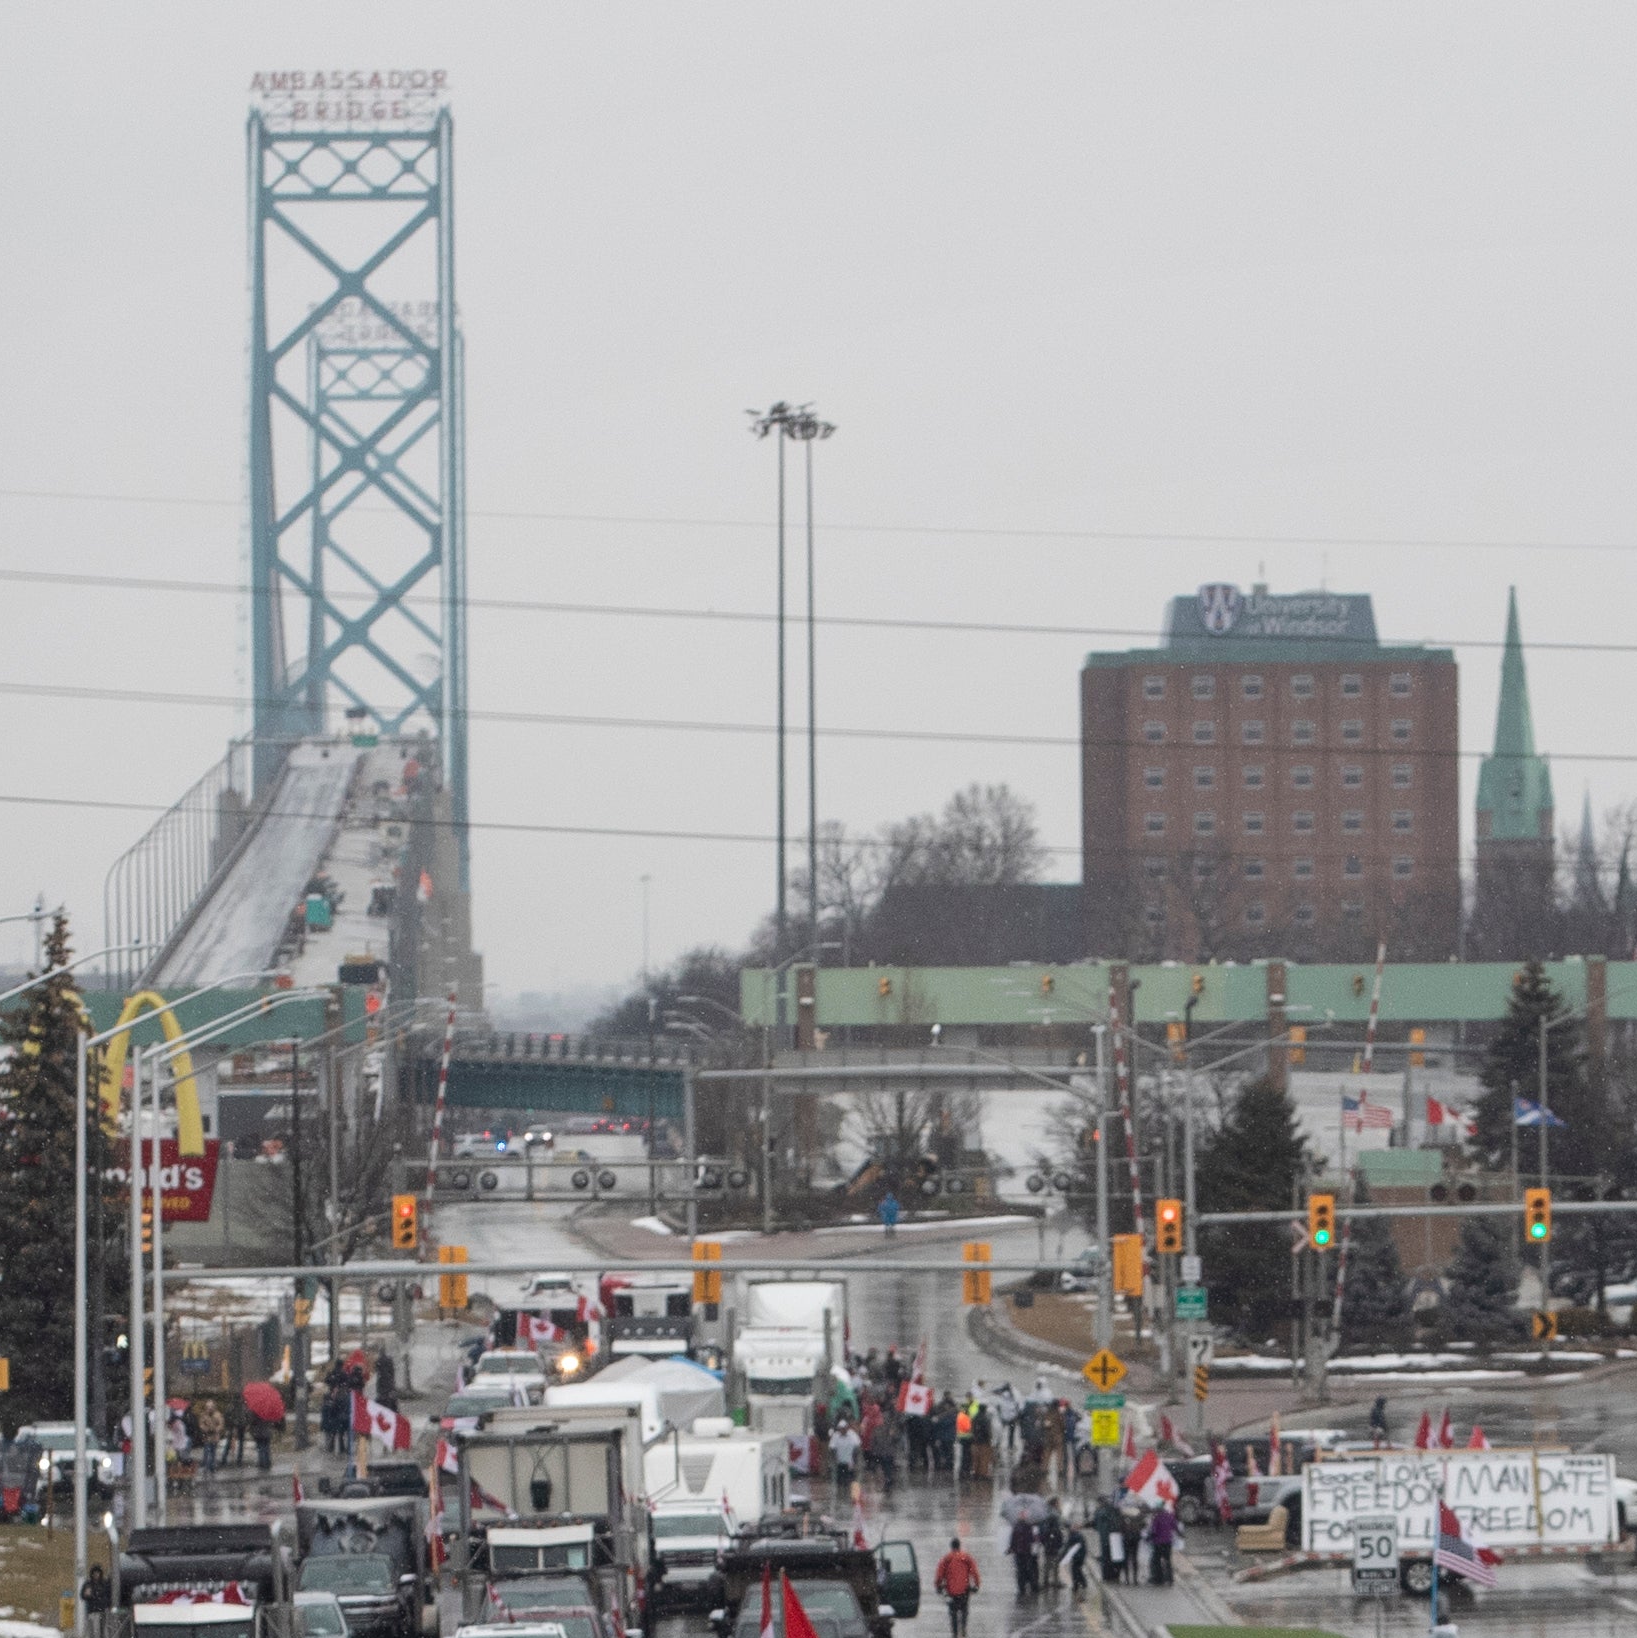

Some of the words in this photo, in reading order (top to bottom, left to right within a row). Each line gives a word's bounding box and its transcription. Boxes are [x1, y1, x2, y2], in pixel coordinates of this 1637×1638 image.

[250, 70, 448, 90] AMBASSADOR
[292, 101, 407, 119] BRIDGE
[1310, 1467, 1375, 1485] Peace
[1456, 1464, 1606, 1499] MANDATE
[1453, 1505, 1594, 1533] FREEDOM
[1360, 1536, 1393, 1559] 50
